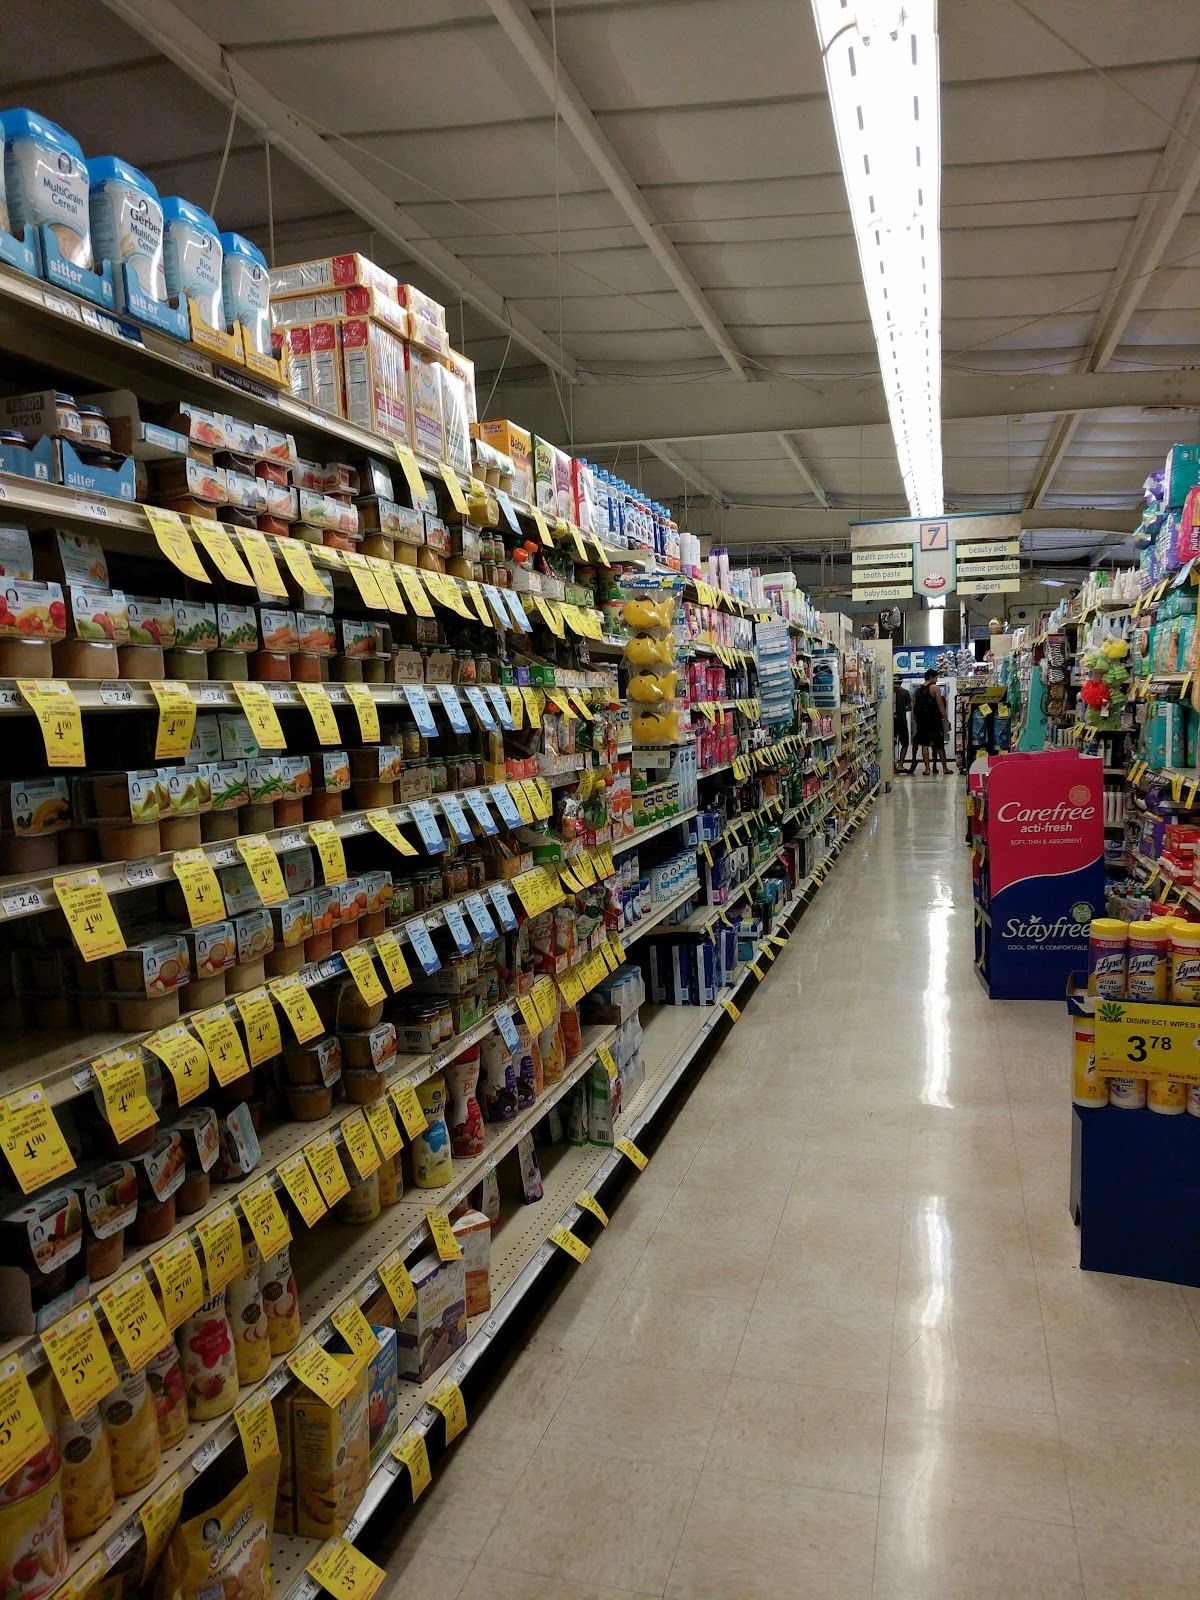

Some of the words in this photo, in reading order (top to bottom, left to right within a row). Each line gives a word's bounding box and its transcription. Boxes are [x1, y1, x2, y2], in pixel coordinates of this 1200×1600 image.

[44, 177, 84, 206] MultiGrain
[52, 194, 78, 214] Cereal
[130, 208, 162, 235] Gerber
[50, 260, 82, 283] sitter
[200, 258, 212, 272] Rice
[130, 294, 158, 315] sitter
[12, 412, 42, 427] 01215
[67, 472, 95, 488] sitter
[928, 527, 940, 546] 7
[878, 552, 908, 561] products
[969, 546, 992, 554] beauty
[958, 564, 986, 572] feminine
[987, 562, 1019, 572] products
[975, 583, 1001, 591] diapers
[2, 692, 22, 703] 2.49
[114, 692, 131, 702] 2.49
[998, 801, 1096, 822] Carefree
[1021, 822, 1072, 833] acti-fresh
[138, 868, 154, 879] 2.49
[19, 895, 40, 908] 2.49
[1002, 916, 1090, 942] Stayfree
[1098, 955, 1124, 971] Lysol
[1129, 956, 1156, 970] Lysol
[1126, 1017, 1167, 1026] DISINFECT
[1170, 1020, 1195, 1028] WIPES
[347, 1518, 358, 1532] 3.79
[242, 1523, 264, 1549] Cookies
[302, 1579, 315, 1597] 3.79
